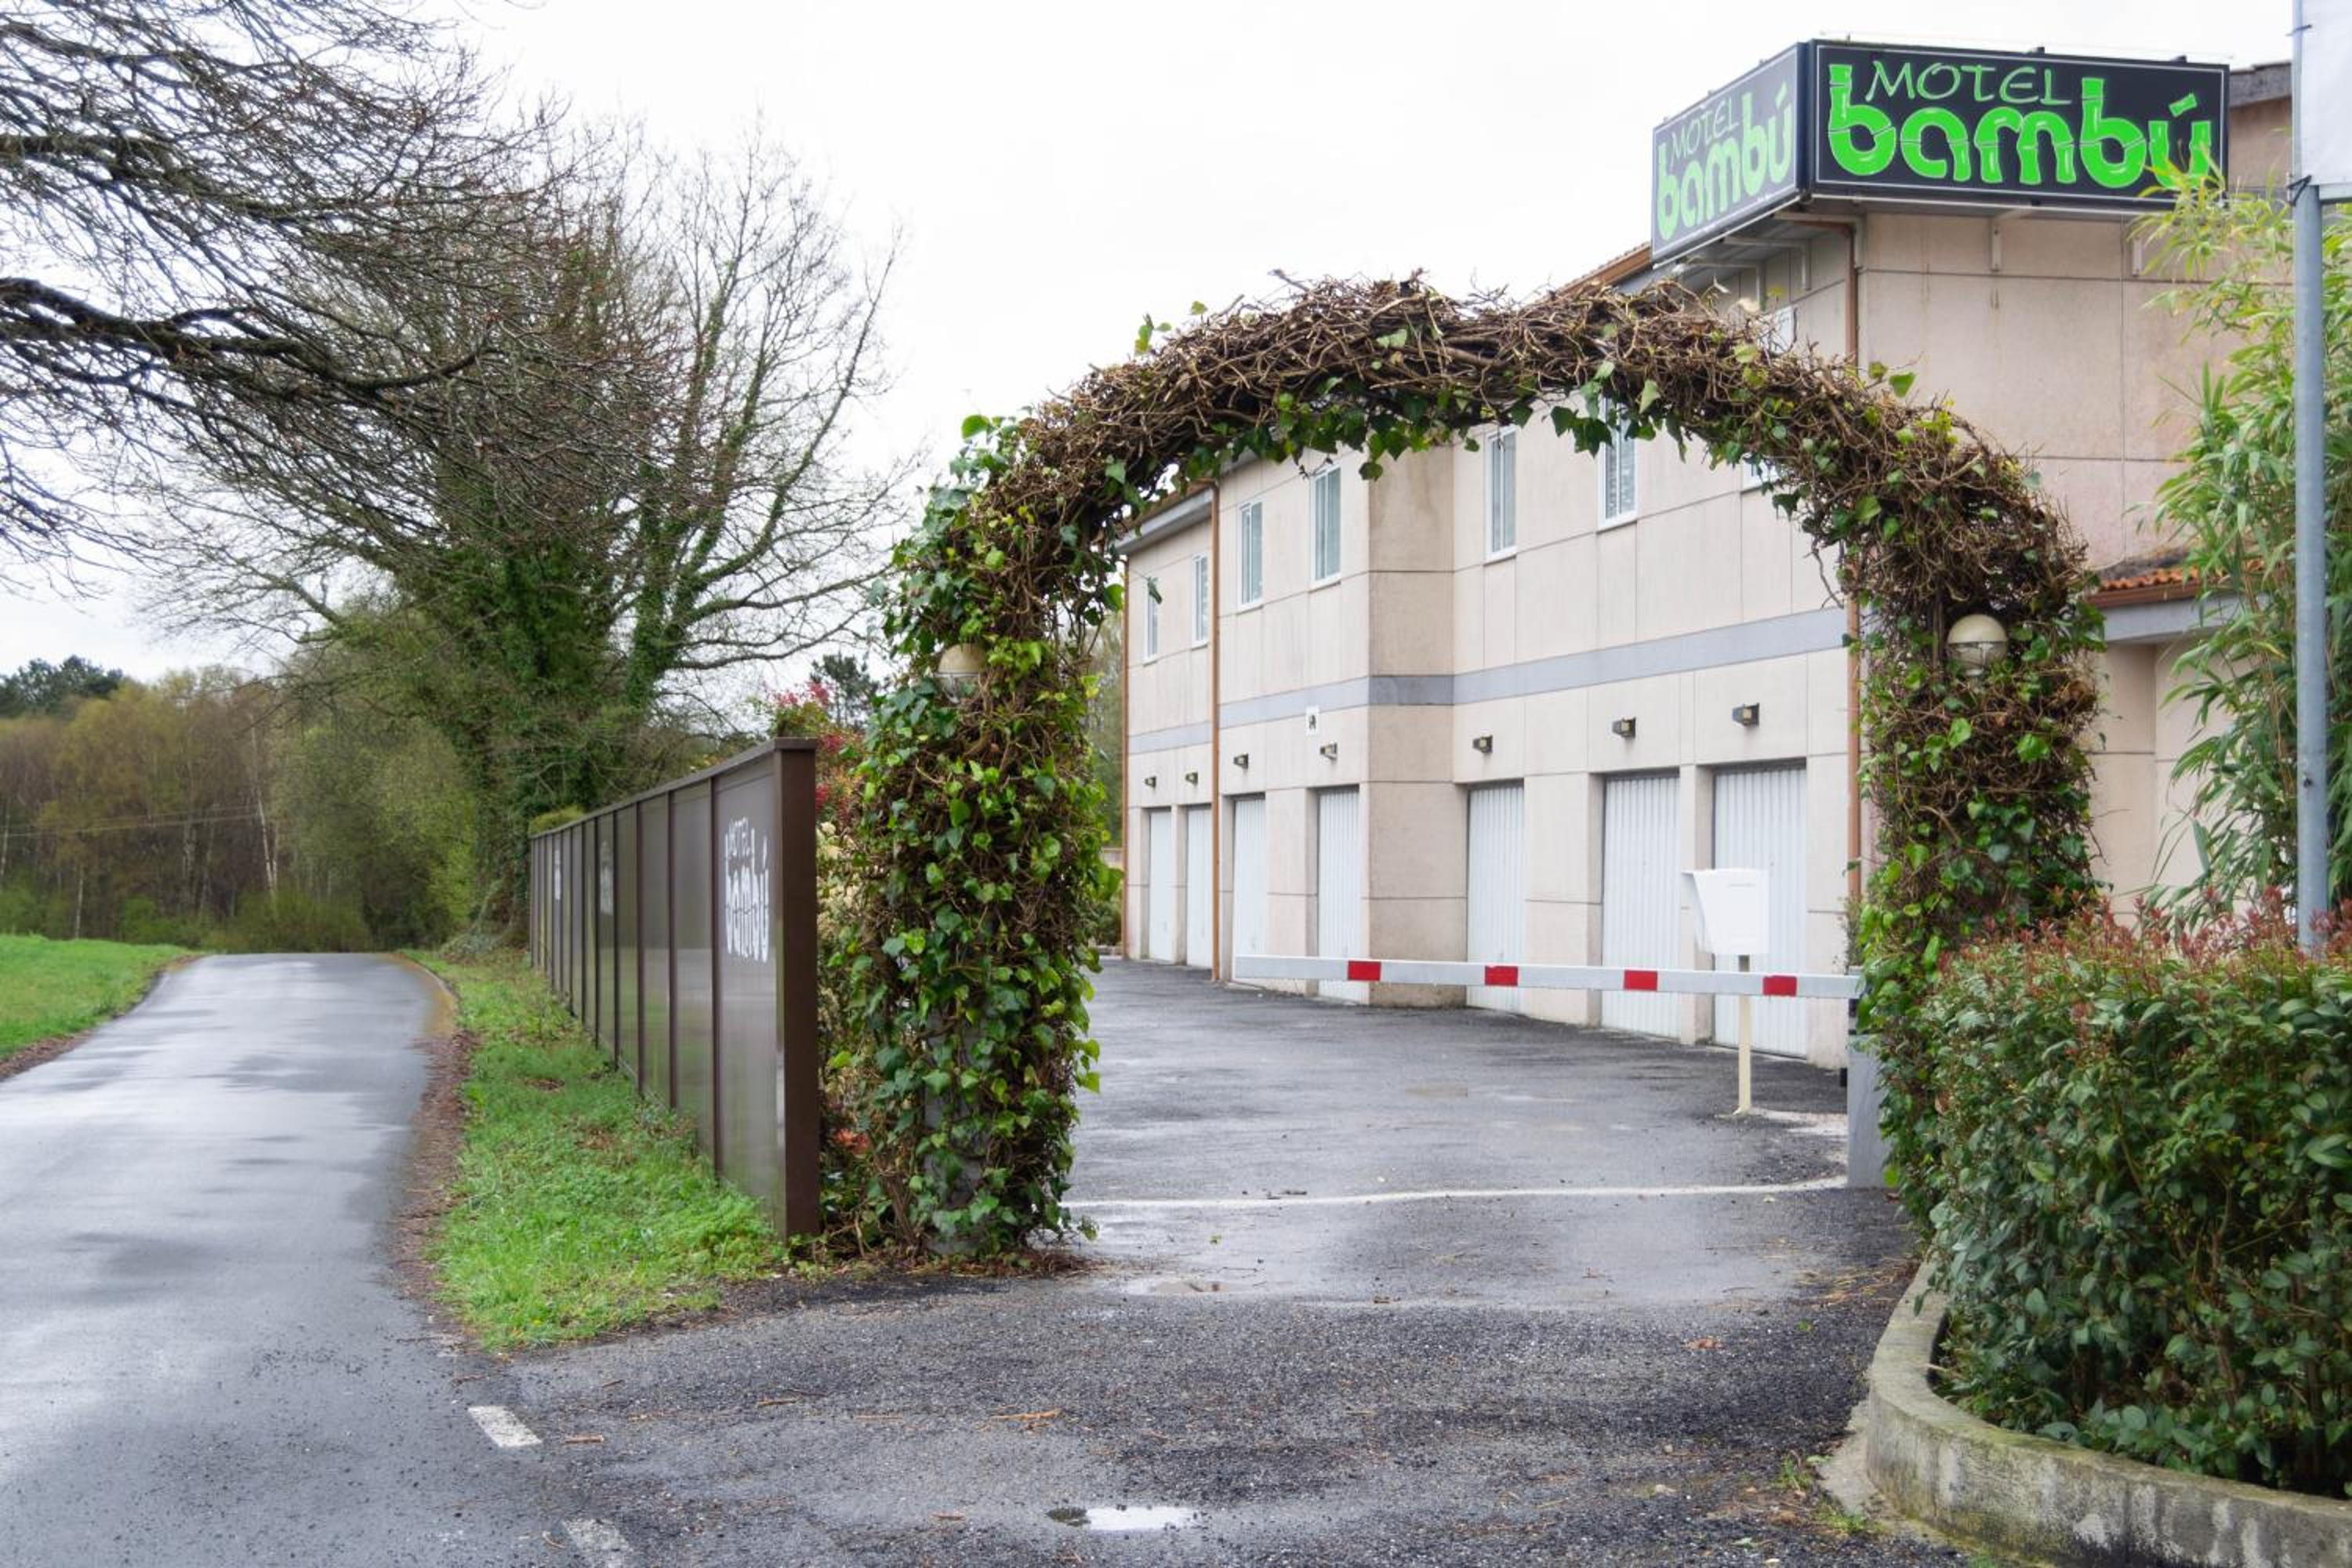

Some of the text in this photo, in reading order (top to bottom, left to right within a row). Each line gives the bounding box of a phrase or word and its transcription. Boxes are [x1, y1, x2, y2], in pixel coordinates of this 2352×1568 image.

[1828, 63, 2212, 189] bambú
[1865, 60, 2071, 105] MOTEL
[1657, 81, 1792, 241] bambú
[1669, 97, 1740, 169] MOTEL
